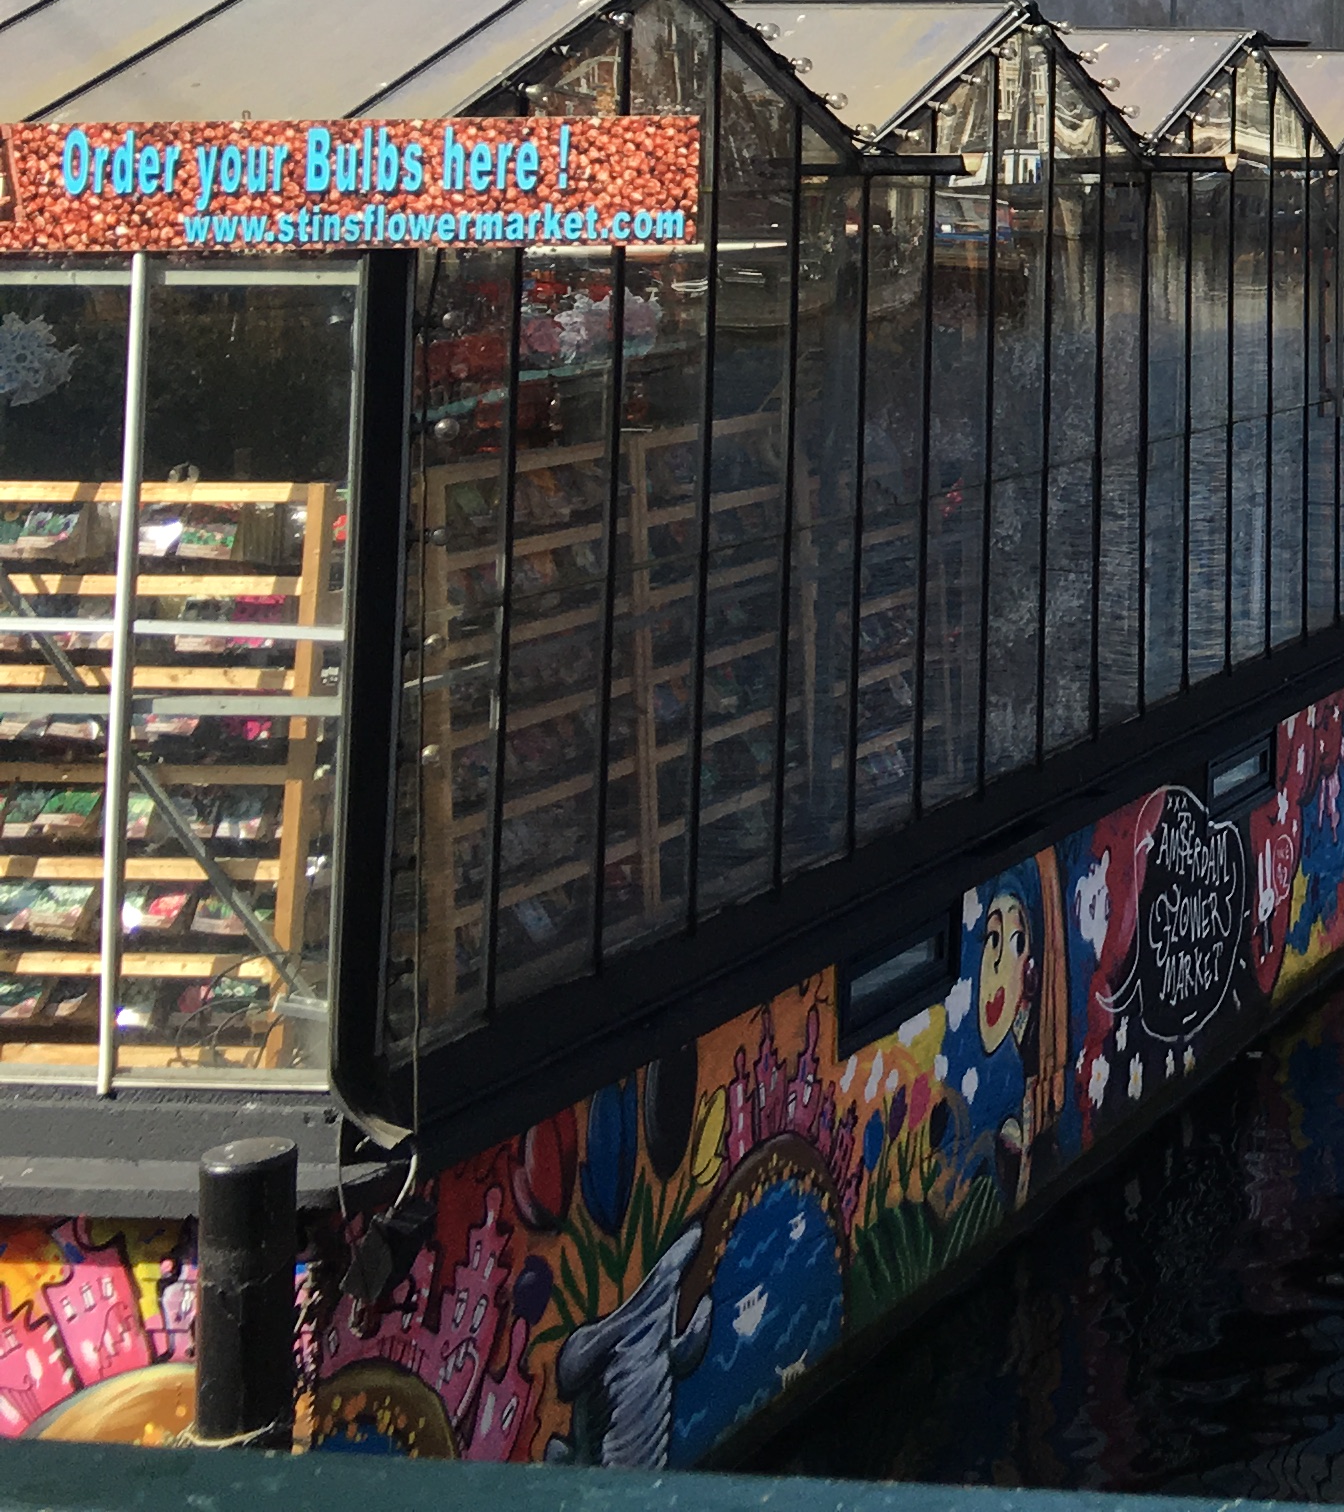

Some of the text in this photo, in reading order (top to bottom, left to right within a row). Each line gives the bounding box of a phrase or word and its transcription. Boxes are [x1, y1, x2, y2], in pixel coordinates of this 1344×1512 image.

[62, 128, 180, 195] Order
[195, 144, 289, 211] your
[306, 126, 424, 193] Bulbs
[443, 126, 539, 191] here
[183, 203, 685, 243] www.stinsflowermarket.com
[1159, 941, 1224, 1006] MARKET
